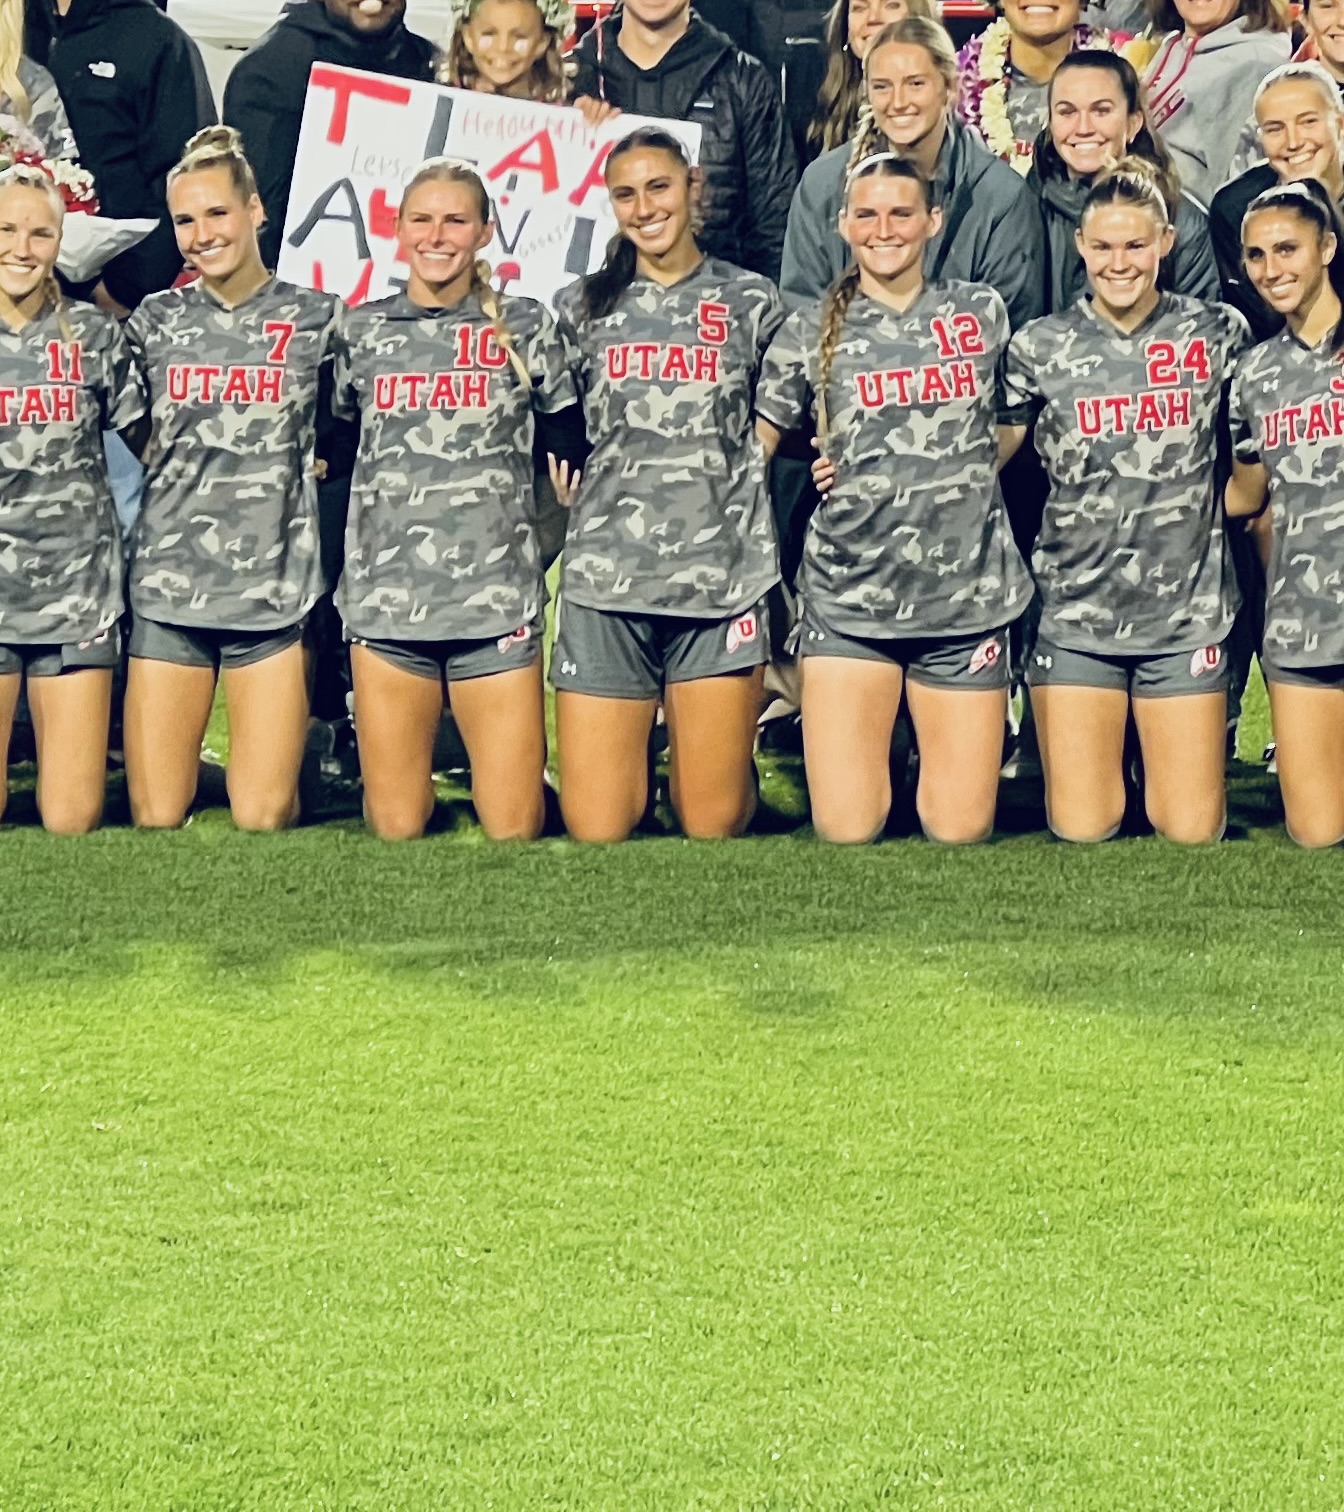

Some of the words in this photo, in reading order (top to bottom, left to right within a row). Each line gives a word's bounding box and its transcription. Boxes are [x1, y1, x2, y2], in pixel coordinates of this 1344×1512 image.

[262, 320, 295, 364] 7
[697, 299, 730, 345] 5
[929, 312, 986, 359] 12
[45, 339, 83, 384] 11
[454, 323, 509, 369] 10
[606, 342, 720, 383] UTAH
[1145, 337, 1211, 388] 24
[167, 364, 284, 405] UTAH
[373, 371, 491, 410] UTAH
[854, 360, 976, 408] UTAH
[1074, 388, 1193, 436] UTAH
